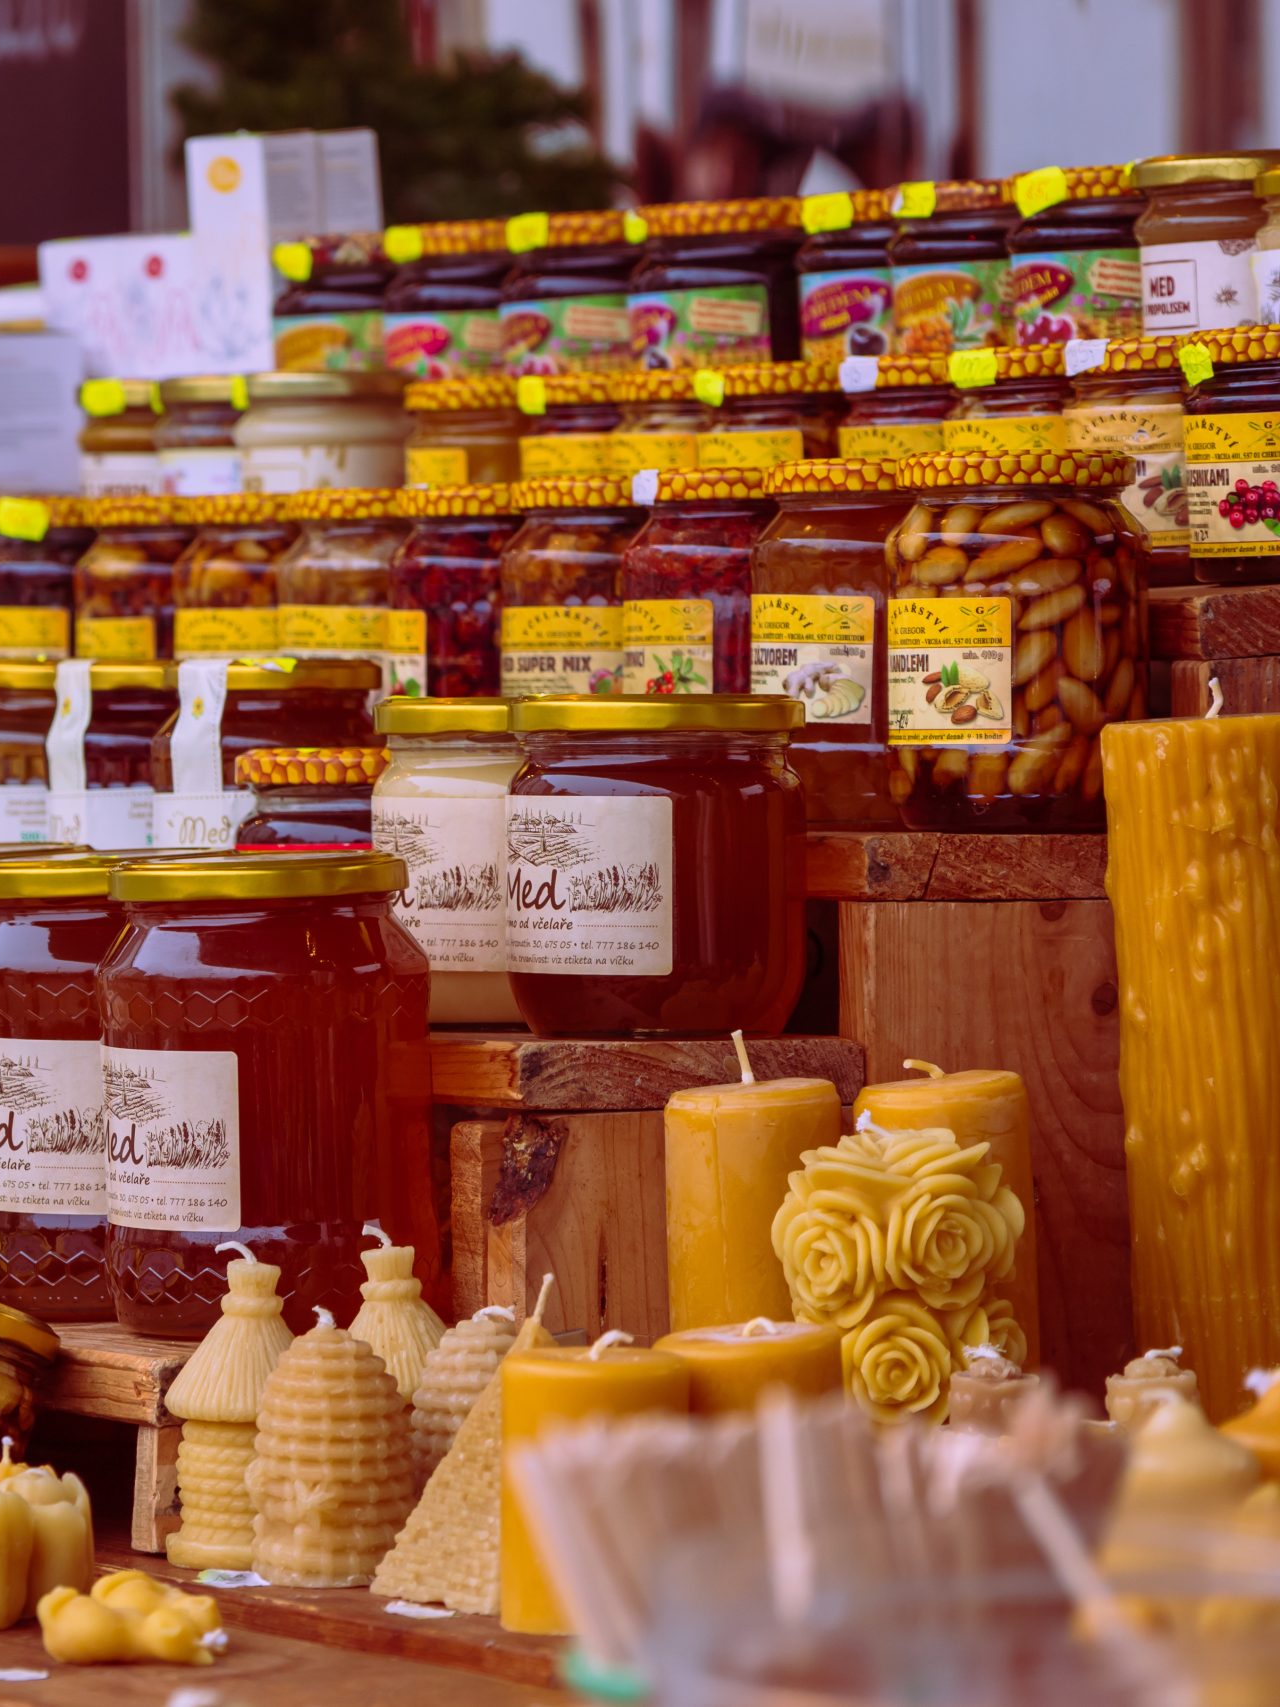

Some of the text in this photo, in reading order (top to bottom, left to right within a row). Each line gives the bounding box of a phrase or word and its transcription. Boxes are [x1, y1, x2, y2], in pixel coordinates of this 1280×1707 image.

[1150, 276, 1175, 298] MED
[1031, 424, 1039, 432] G
[1264, 420, 1273, 429] G
[840, 604, 849, 612] G
[975, 606, 985, 615] G
[900, 626, 926, 635] GREGOR
[972, 637, 1003, 645] CHRUDIM
[517, 656, 592, 673] SUPER MIX
[179, 815, 232, 845] Med
[506, 867, 567, 912] Med
[519, 917, 529, 930] od
[532, 916, 574, 931] včelaře
[439, 938, 457, 947] 777
[458, 938, 477, 948] 186
[478, 939, 499, 948] 140
[544, 940, 558, 948] 675
[559, 940, 571, 949] 05
[580, 940, 594, 950] tel.
[596, 941, 614, 950] 777
[616, 941, 636, 950] 186
[638, 941, 660, 951] 140
[439, 952, 475, 963] na víčku
[551, 954, 563, 965] viz
[564, 954, 593, 966] etiketa
[595, 957, 607, 966] na
[610, 955, 634, 966] víčku
[109, 1170, 151, 1186] od včelaře
[2, 1178, 16, 1188] 675
[17, 1179, 31, 1189] 05
[38, 1179, 51, 1190] tel.
[53, 1181, 71, 1190] 777
[73, 1182, 92, 1191] 186
[94, 1183, 107, 1192] 14
[9, 1193, 20, 1204] viz
[22, 1194, 50, 1205] etiketa
[52, 1197, 64, 1206] na
[66, 1196, 90, 1207] víčku
[140, 1195, 150, 1205] 05
[156, 1196, 168, 1207] tel.
[169, 1197, 185, 1206] 777
[187, 1198, 206, 1207] 186
[207, 1198, 228, 1208] 140
[144, 1209, 167, 1221] etiketa
[169, 1212, 180, 1221] na
[181, 1211, 204, 1223] víčku
